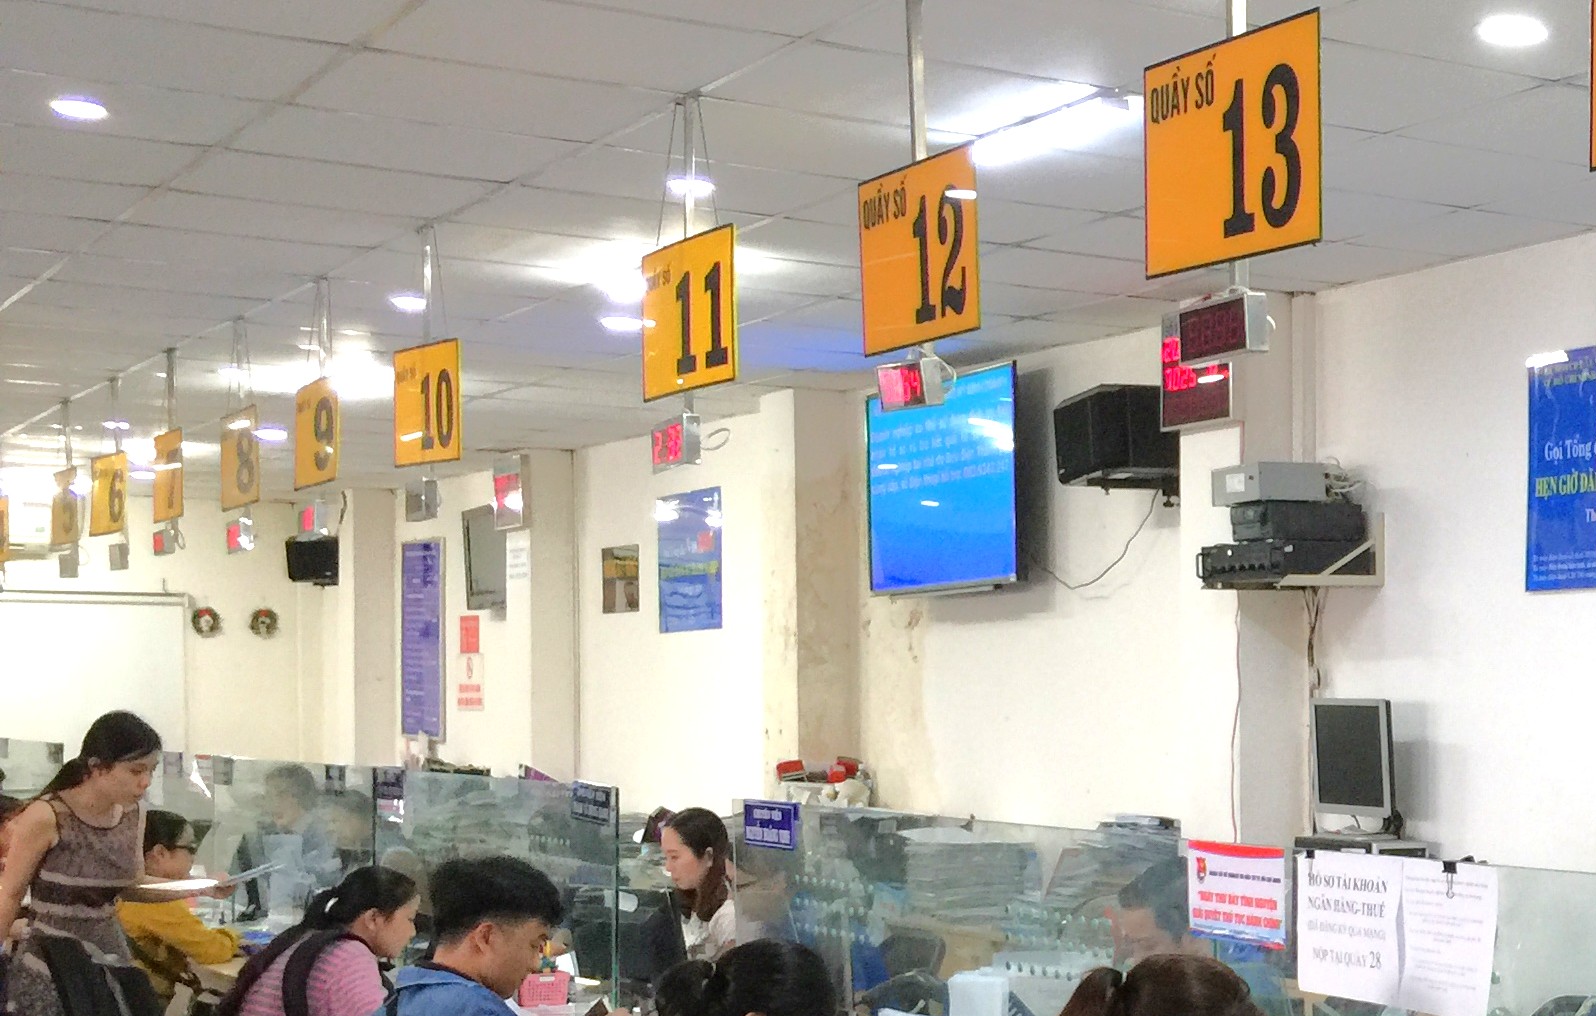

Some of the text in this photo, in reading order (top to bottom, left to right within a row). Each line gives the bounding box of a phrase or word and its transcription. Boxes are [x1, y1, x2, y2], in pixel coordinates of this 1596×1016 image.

[1150, 53, 1217, 125] QUẦY SỐ
[1222, 62, 1301, 239] 13
[862, 174, 908, 231] QUẦY SỐ
[912, 183, 967, 325] 12
[675, 260, 729, 376] 11
[314, 395, 335, 471] 9
[420, 367, 454, 450] 10
[236, 428, 255, 494] 8
[1544, 440, 1563, 466] Gọi
[1564, 433, 1593, 461] Tổng
[108, 468, 125, 523] 6
[1369, 950, 1382, 970] 28
